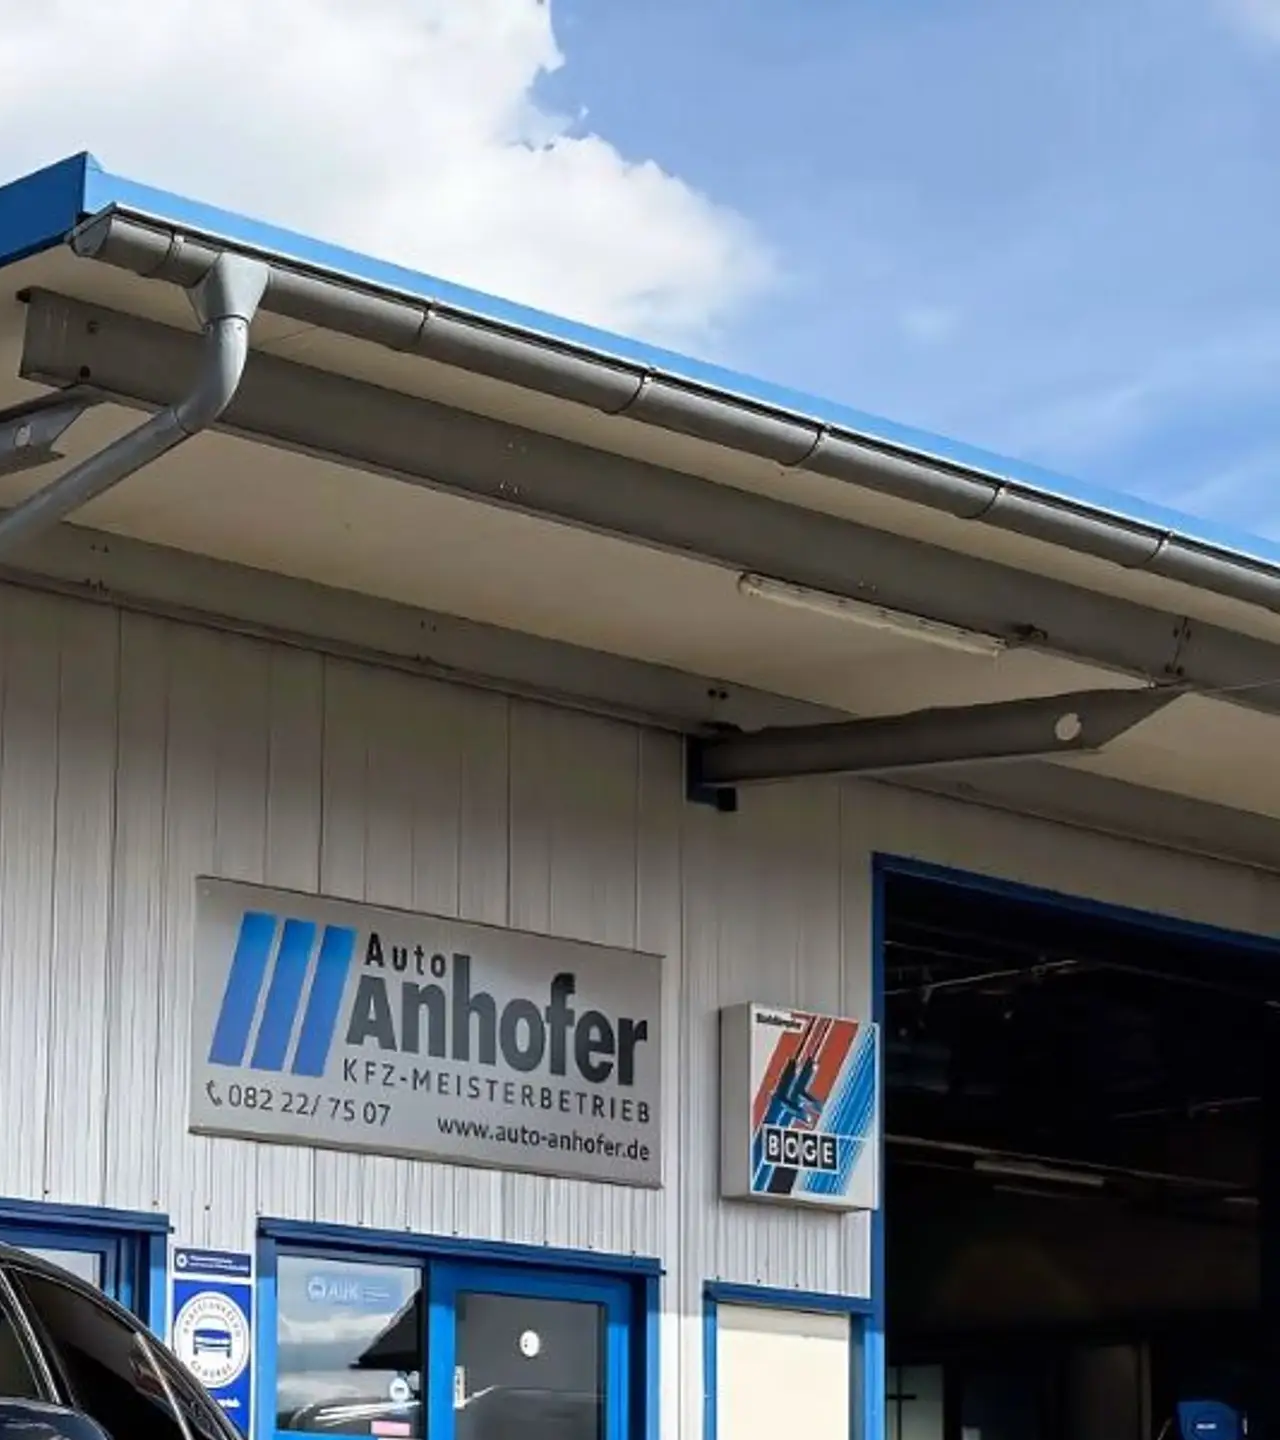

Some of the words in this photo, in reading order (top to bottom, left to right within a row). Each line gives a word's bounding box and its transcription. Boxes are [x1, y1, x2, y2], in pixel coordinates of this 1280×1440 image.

[364, 931, 447, 979] Auto
[345, 953, 648, 1086] Anhofer
[343, 1057, 651, 1124] KFZ-MEISTERBETRIEB
[437, 1116, 651, 1162] www.auto-anhofer.de
[767, 1133, 835, 1165] BOGE
